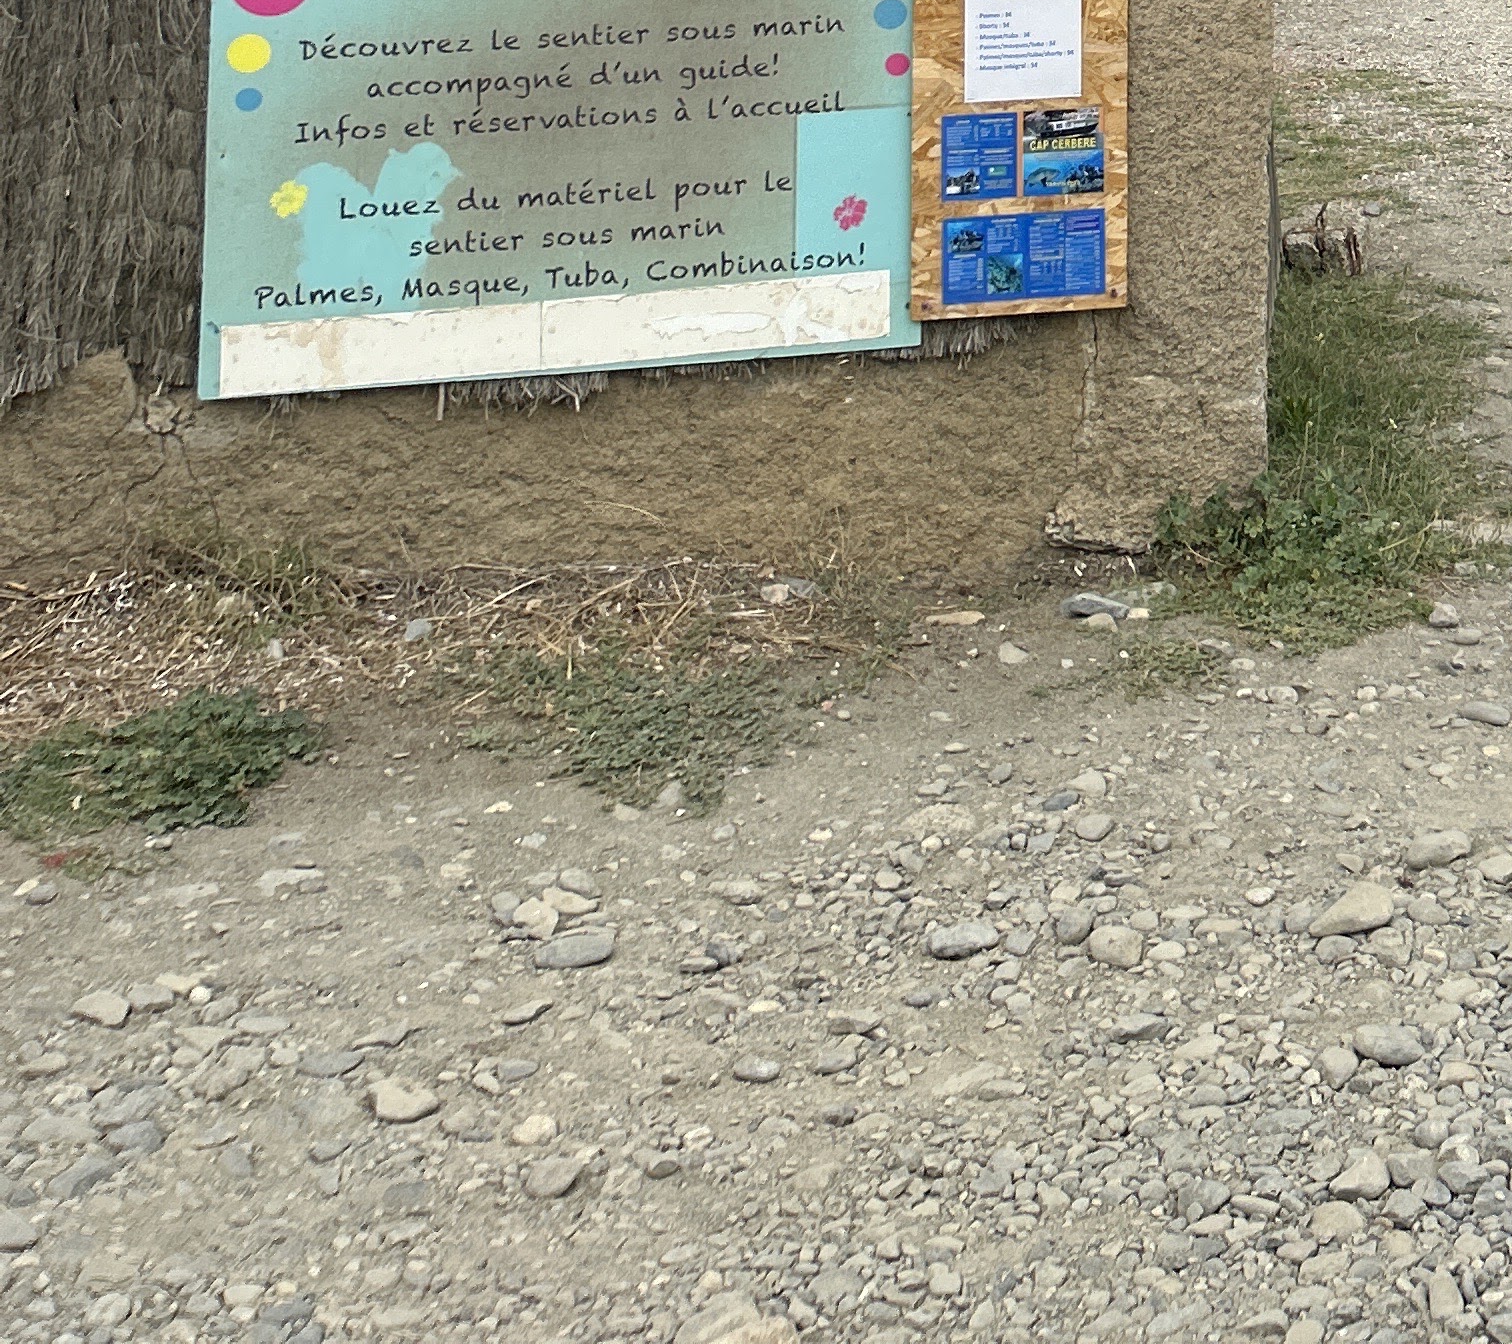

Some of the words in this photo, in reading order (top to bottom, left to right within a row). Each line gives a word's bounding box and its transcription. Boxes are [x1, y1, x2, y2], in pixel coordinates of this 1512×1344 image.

[298, 32, 474, 62] Découvrez
[490, 28, 521, 51] le
[537, 22, 650, 50] sentier
[666, 22, 737, 43] sous
[753, 13, 846, 38] marin
[367, 62, 573, 106] accompagné
[588, 60, 664, 86] d'un
[679, 52, 781, 90] guide!
[294, 113, 388, 148] Infos
[404, 113, 436, 138] et
[452, 105, 658, 135] réservations
[674, 97, 692, 122] à
[707, 90, 847, 120] l'accueil
[1029, 139, 1050, 151] CAP
[1051, 137, 1097, 150] CERBERE
[339, 196, 441, 220] Louez
[457, 186, 501, 211] du
[517, 177, 657, 208] matériel
[674, 176, 748, 213] pour
[764, 169, 793, 192] le
[409, 230, 525, 257] sentier
[541, 225, 613, 249] sous
[630, 217, 725, 243] marin
[254, 282, 384, 310] Palmes,
[401, 274, 530, 306] Masque,
[545, 260, 630, 289] Tuba,
[646, 241, 866, 282] Combinaison!
